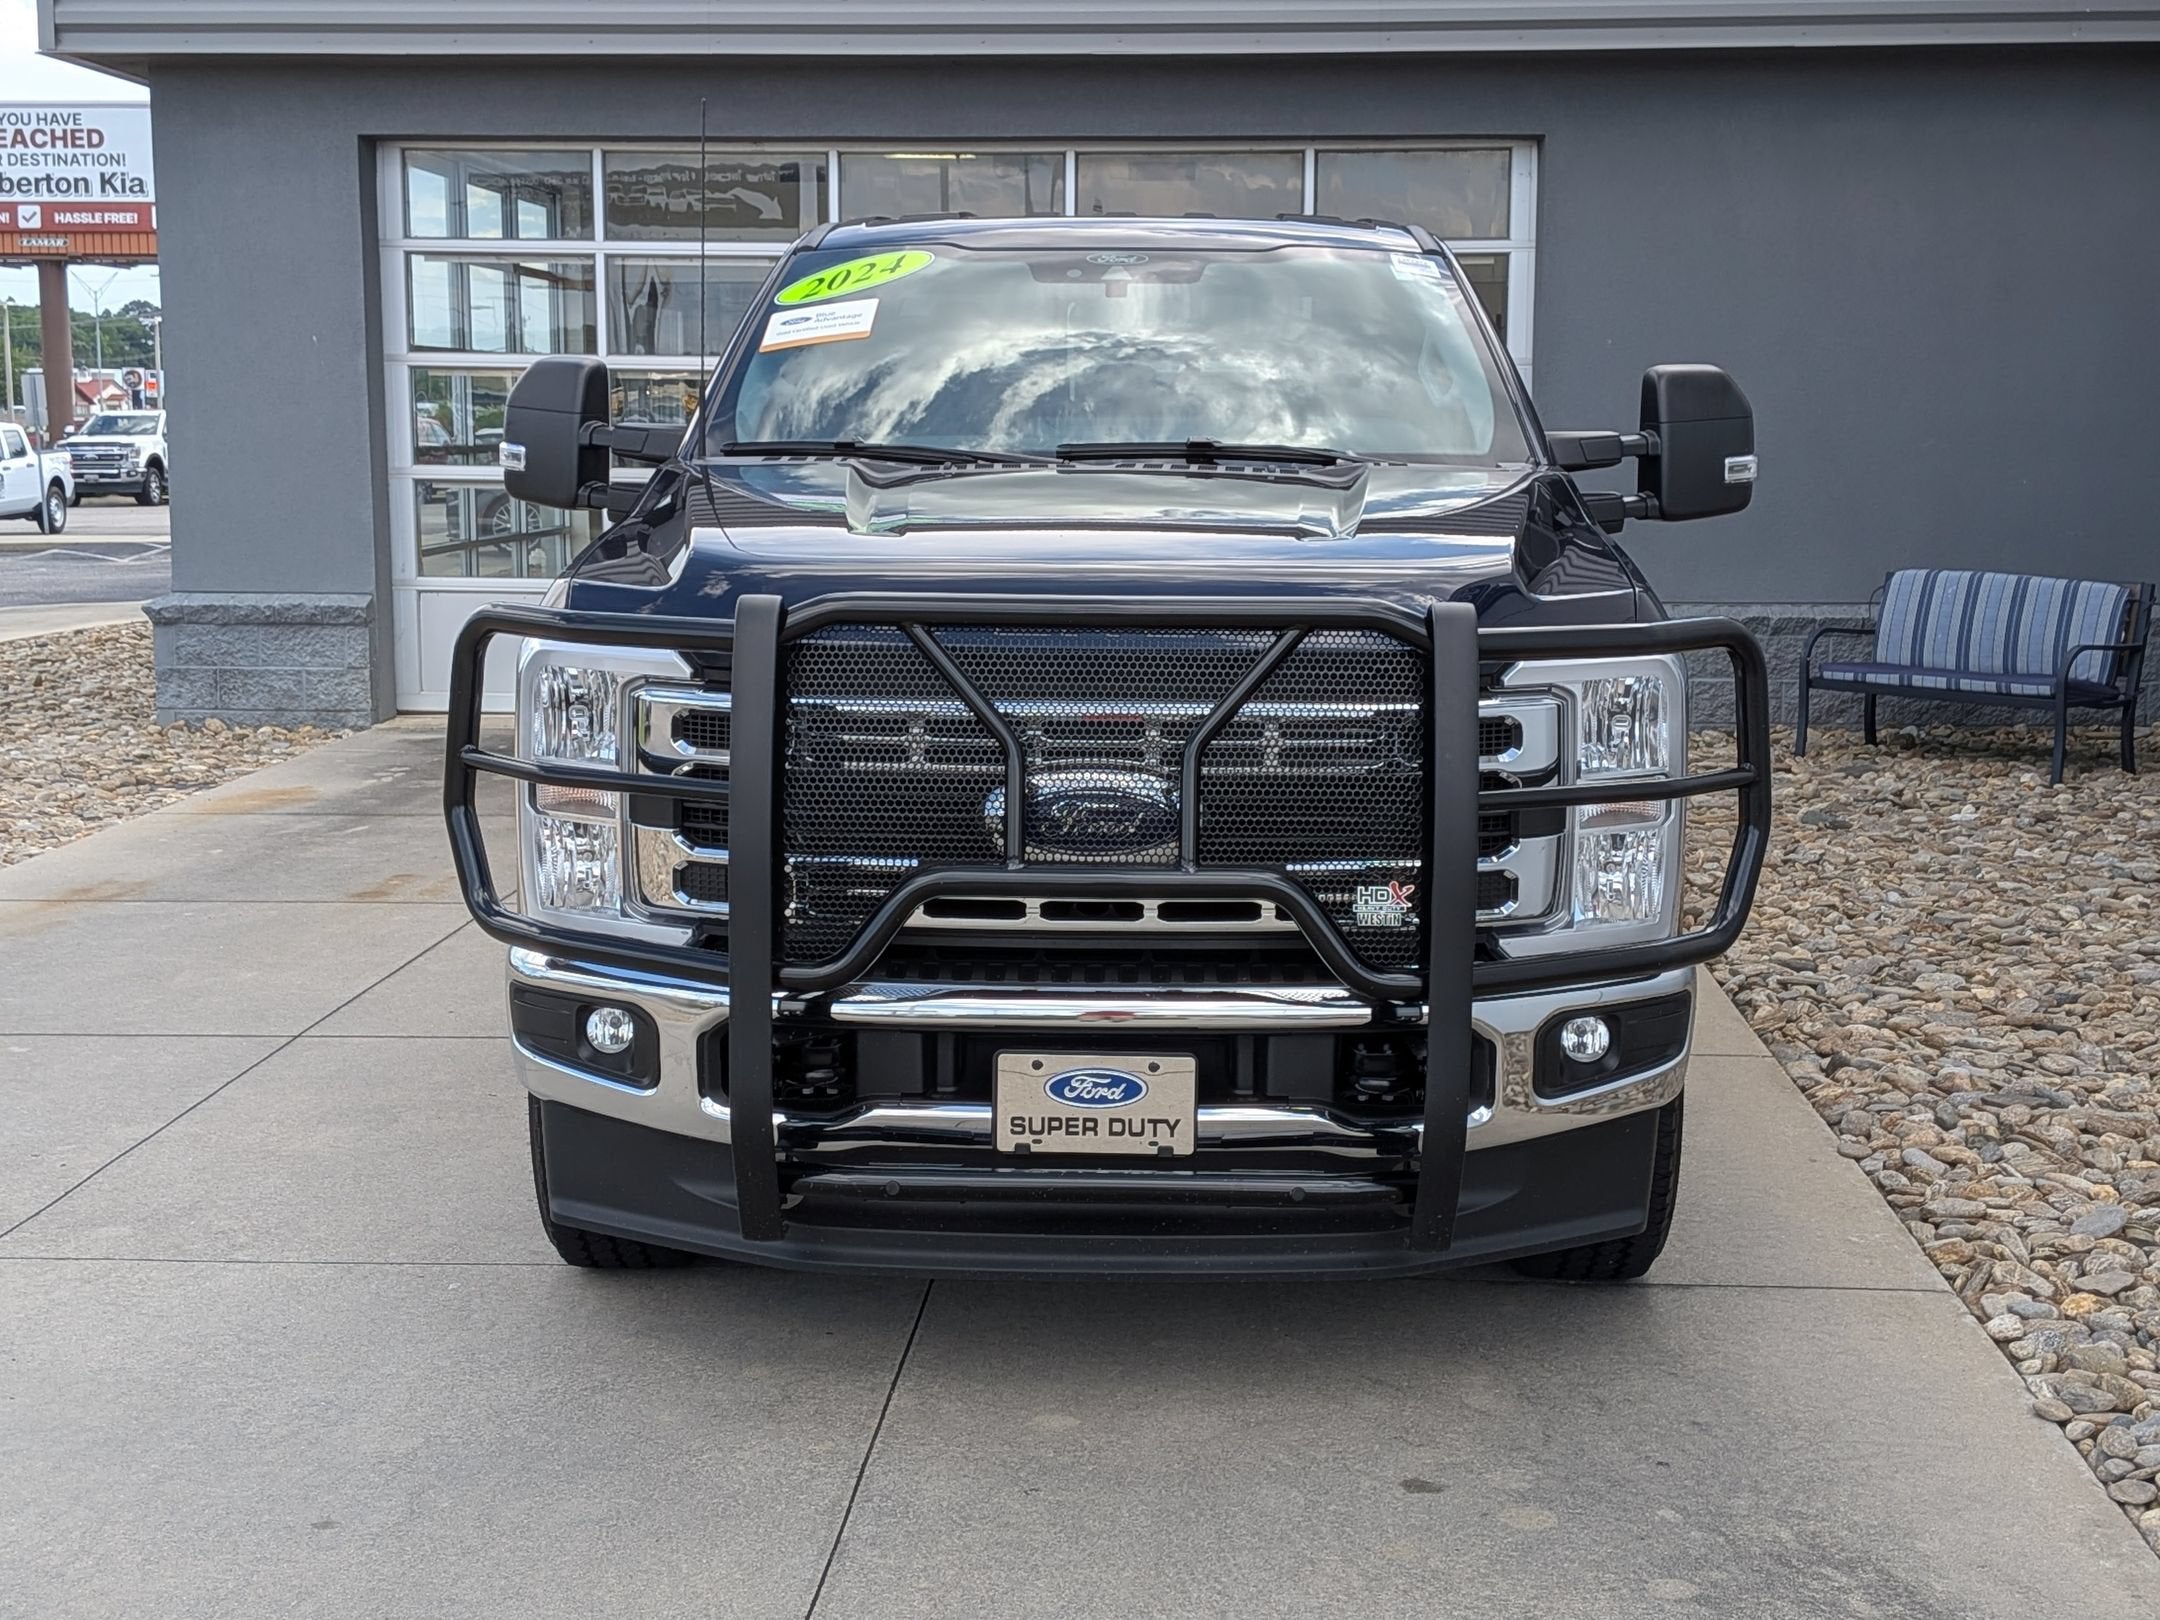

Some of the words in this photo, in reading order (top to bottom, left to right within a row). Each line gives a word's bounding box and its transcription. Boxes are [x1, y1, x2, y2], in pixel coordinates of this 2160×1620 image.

[0, 112, 31, 126] YOU
[36, 112, 82, 126] HAVE
[7, 153, 126, 167] DESTINATION!
[100, 172, 146, 194] Kia
[54, 212, 103, 224] HASSLE
[1097, 255, 1138, 264] Ford
[800, 254, 907, 300] 2024
[1357, 880, 1416, 908] HDX
[1063, 1075, 1127, 1101] Ford
[1010, 1116, 1099, 1137] SUPER
[1108, 1117, 1182, 1138] DUTY
